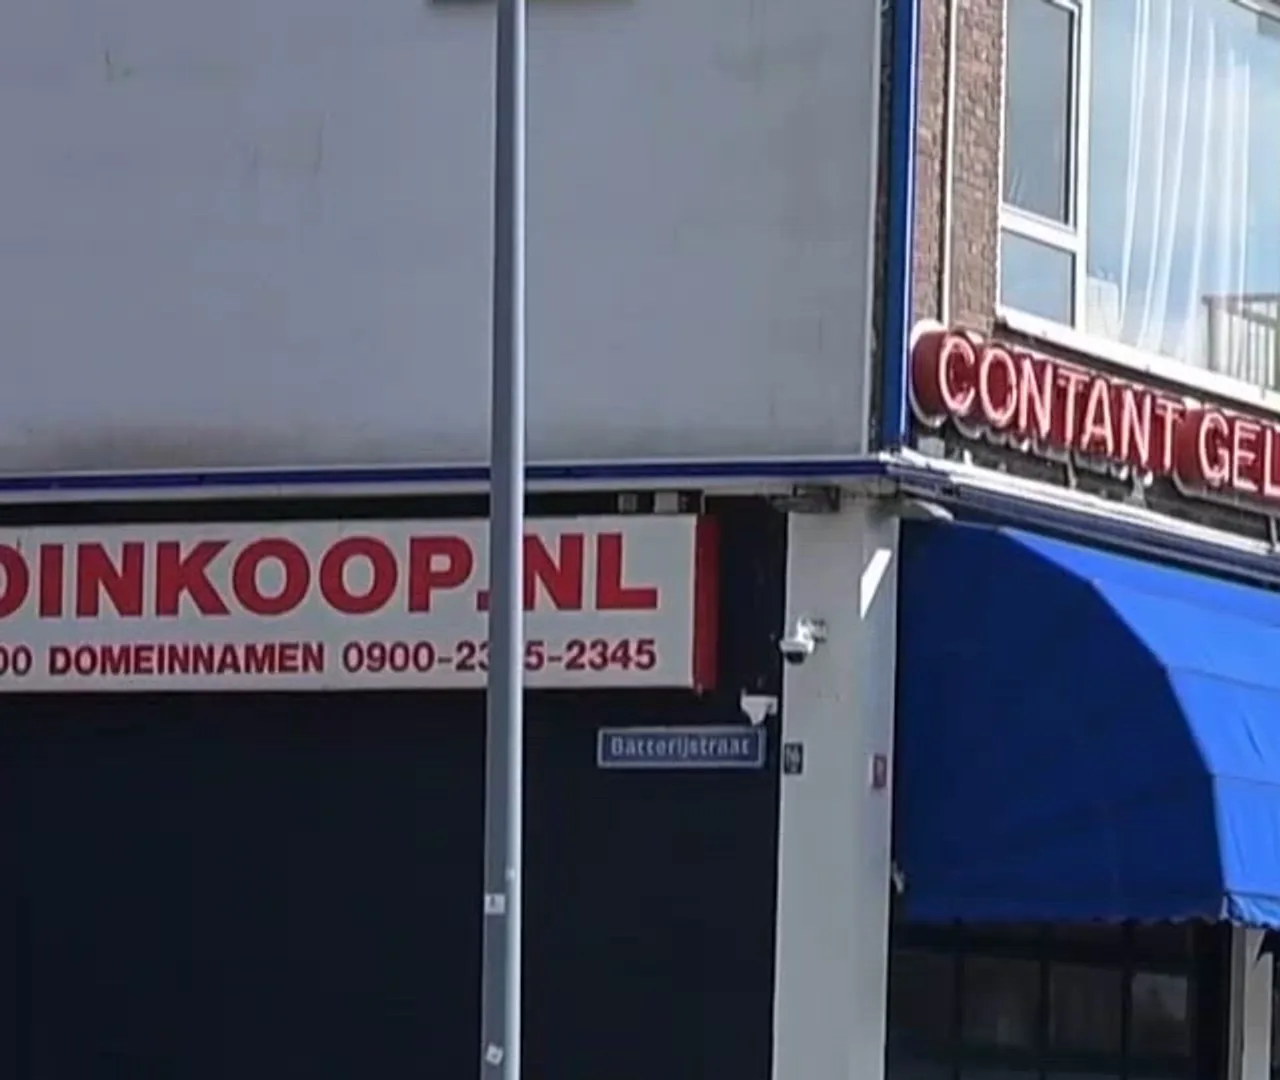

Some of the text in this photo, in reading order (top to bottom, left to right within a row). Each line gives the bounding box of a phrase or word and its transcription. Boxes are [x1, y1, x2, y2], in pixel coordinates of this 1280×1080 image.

[937, 333, 1185, 472] CONTANT
[48, 642, 325, 677] DOMEINNAMEN
[342, 638, 657, 673] 0900-235-2345
